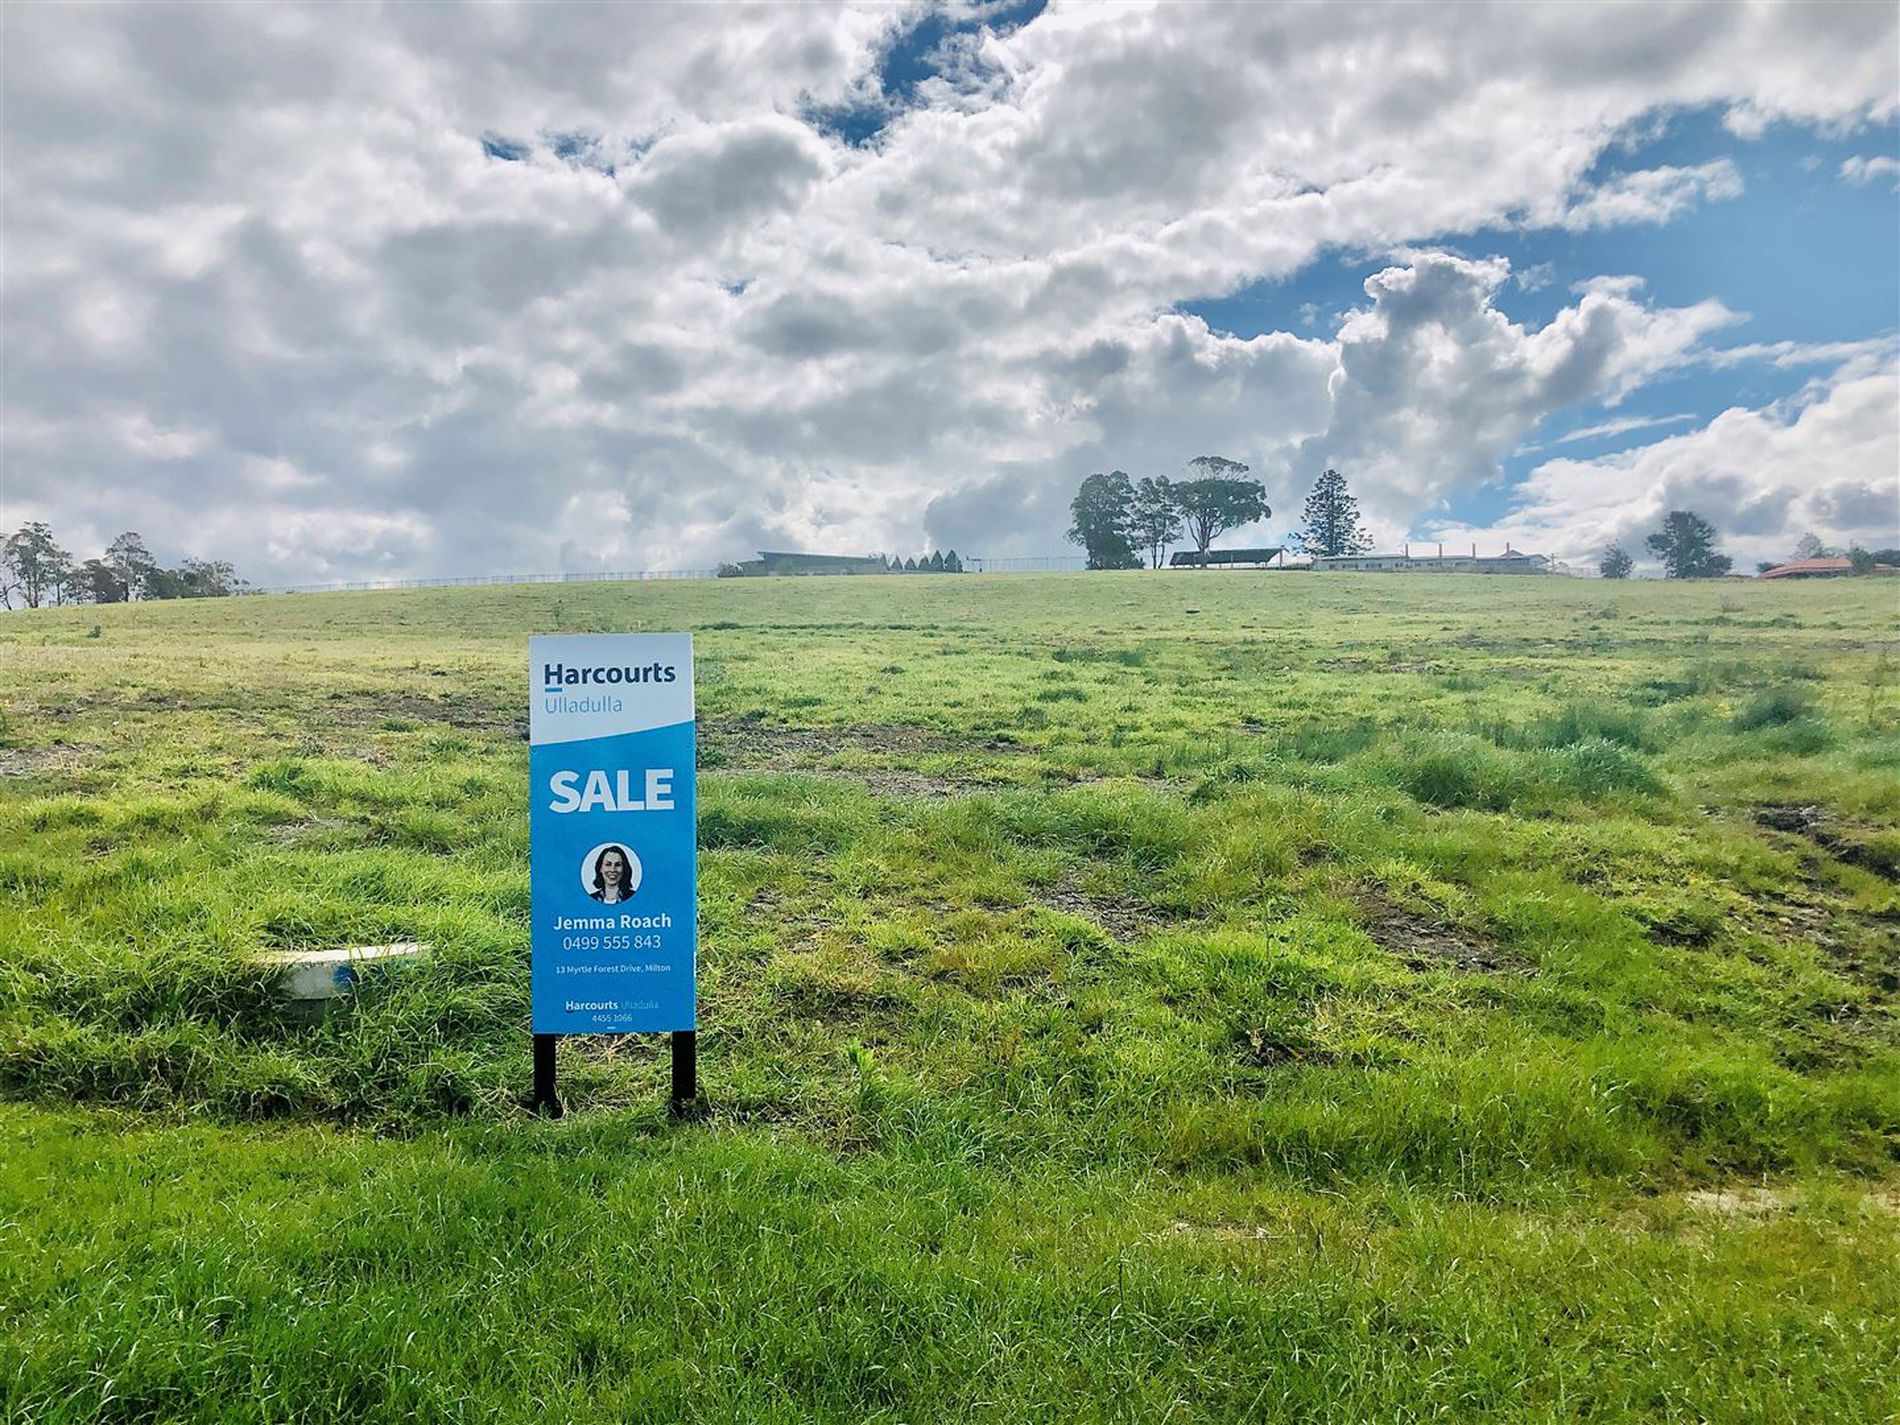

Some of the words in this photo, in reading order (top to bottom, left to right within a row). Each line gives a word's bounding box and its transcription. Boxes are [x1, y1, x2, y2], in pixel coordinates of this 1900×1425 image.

[544, 663, 676, 685] Harcourts
[545, 696, 622, 714] Ulladulla
[549, 768, 675, 814] SALE
[554, 916, 615, 930] Jemma
[620, 913, 672, 928] Roach
[563, 936, 599, 950] 0499
[603, 936, 630, 949] 555
[634, 935, 661, 948] 843
[567, 965, 592, 976] Myrtle
[593, 965, 619, 973] Forest
[645, 963, 671, 972] Milton
[565, 1001, 618, 1011] Harcourts
[592, 1014, 611, 1022] 4455
